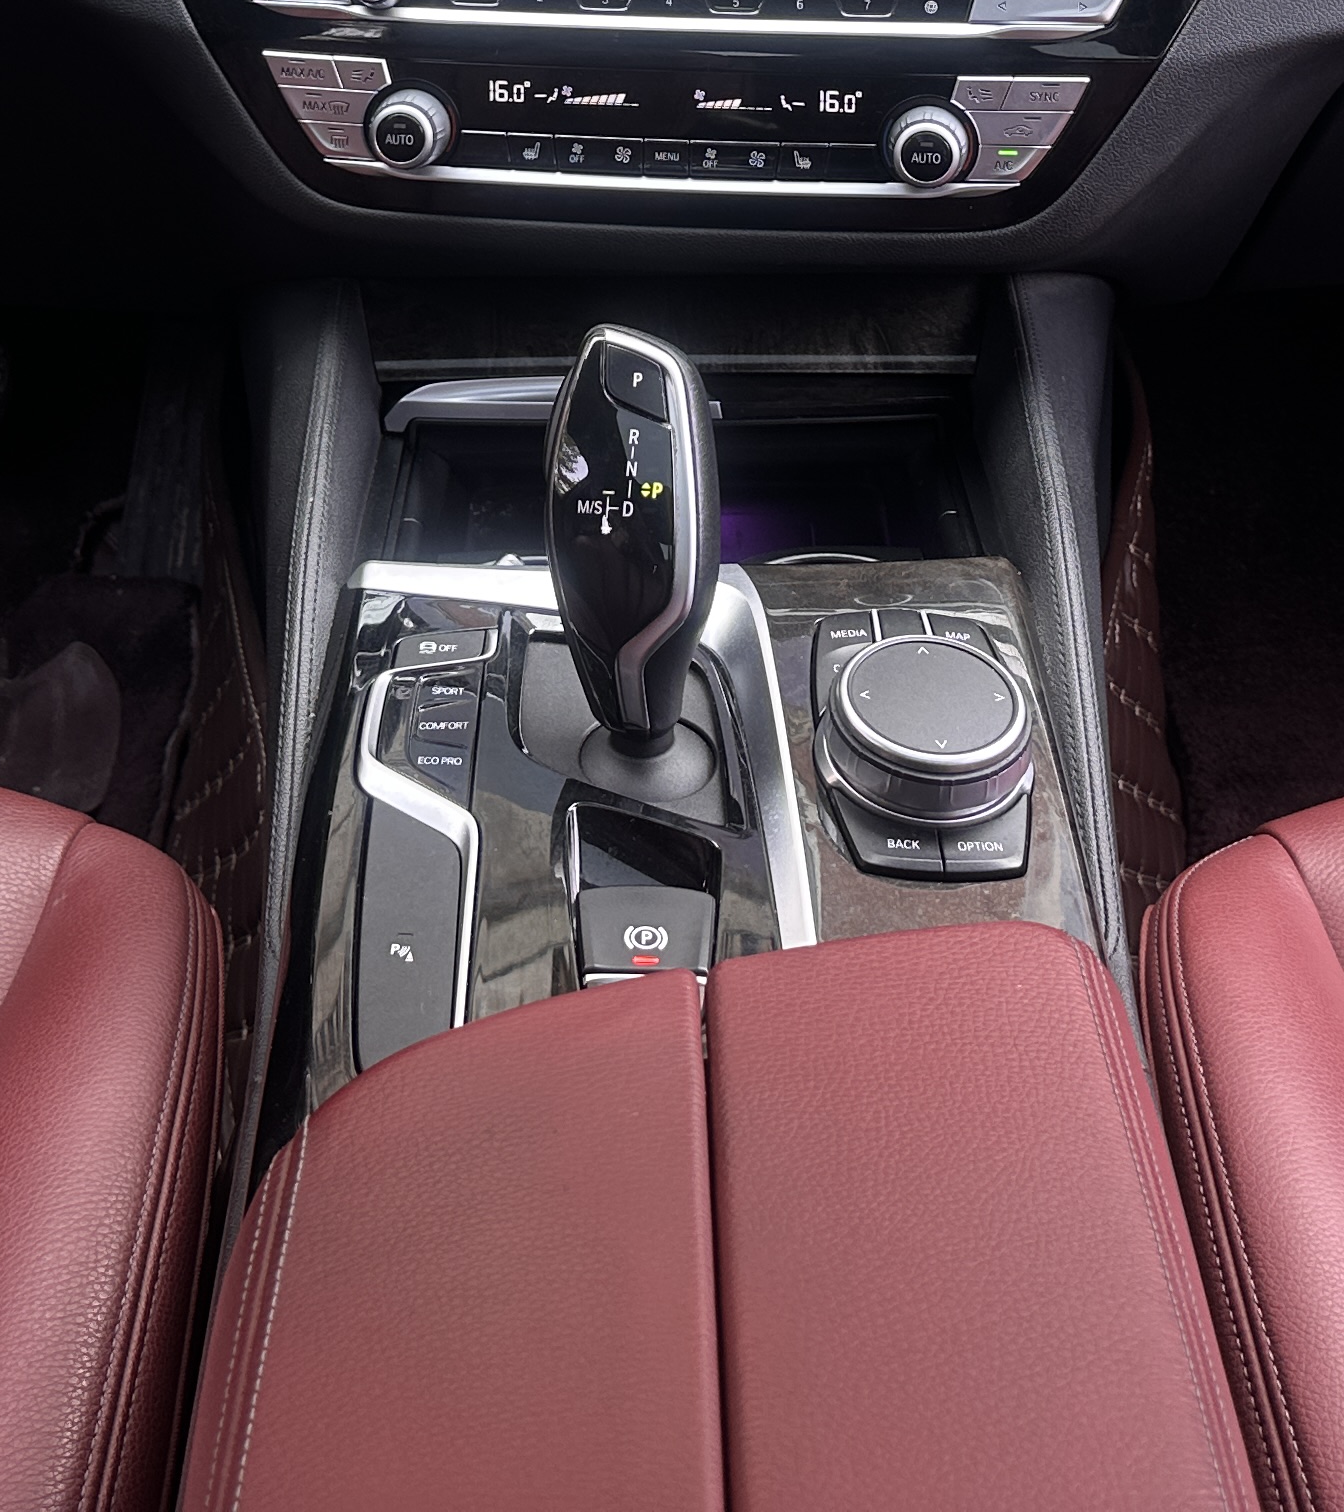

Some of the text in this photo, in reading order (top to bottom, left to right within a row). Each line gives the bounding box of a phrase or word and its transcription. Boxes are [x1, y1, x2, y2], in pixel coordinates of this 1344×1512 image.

[863, 0, 872, 11] 7
[280, 66, 305, 79] MAX
[1029, 91, 1060, 102] SYNC
[302, 100, 327, 112] MAX
[385, 133, 415, 146] AUTO
[568, 153, 585, 164] OFF
[654, 151, 680, 162] MENU
[910, 151, 942, 165] AUTO
[702, 158, 719, 169] OFF
[993, 160, 1014, 172] A/C
[631, 372, 644, 388] P
[628, 428, 640, 445] R
[625, 460, 639, 477] N
[651, 481, 664, 500] P
[577, 499, 634, 518] M/S D
[830, 628, 868, 640] MEDIA
[944, 630, 972, 642] MAP
[438, 644, 459, 653] OFF
[431, 685, 465, 696] SPORT
[418, 720, 470, 731] COMFORT
[417, 755, 463, 767] ECO PRO
[886, 837, 921, 851] BACK
[957, 841, 1004, 853] OPTION
